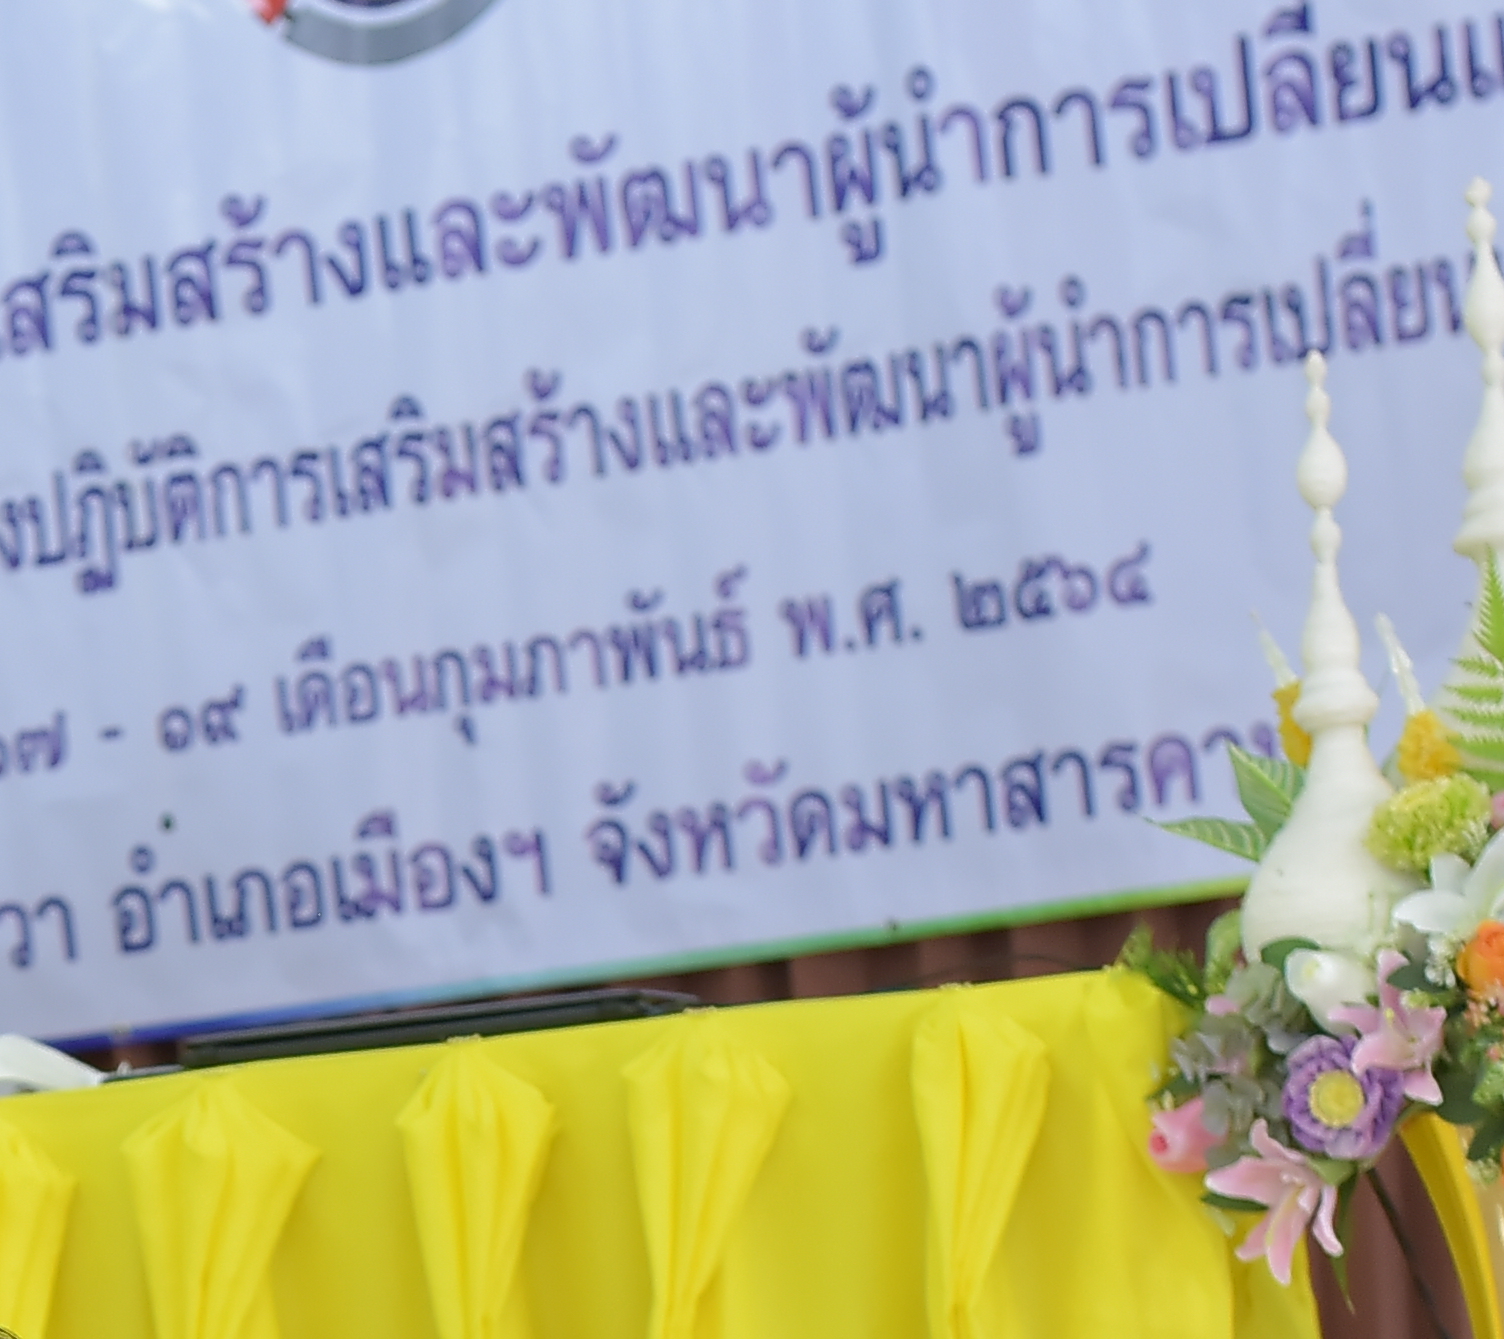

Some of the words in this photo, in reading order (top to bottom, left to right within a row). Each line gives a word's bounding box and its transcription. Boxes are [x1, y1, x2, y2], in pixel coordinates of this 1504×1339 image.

[274, 563, 754, 746] เดือนกุมภาพันธ์
[780, 576, 924, 657] พ.ศ.
[948, 539, 1154, 631] ๒๕๖๔
[586, 720, 1276, 888] จังหวัดมหาสารค
